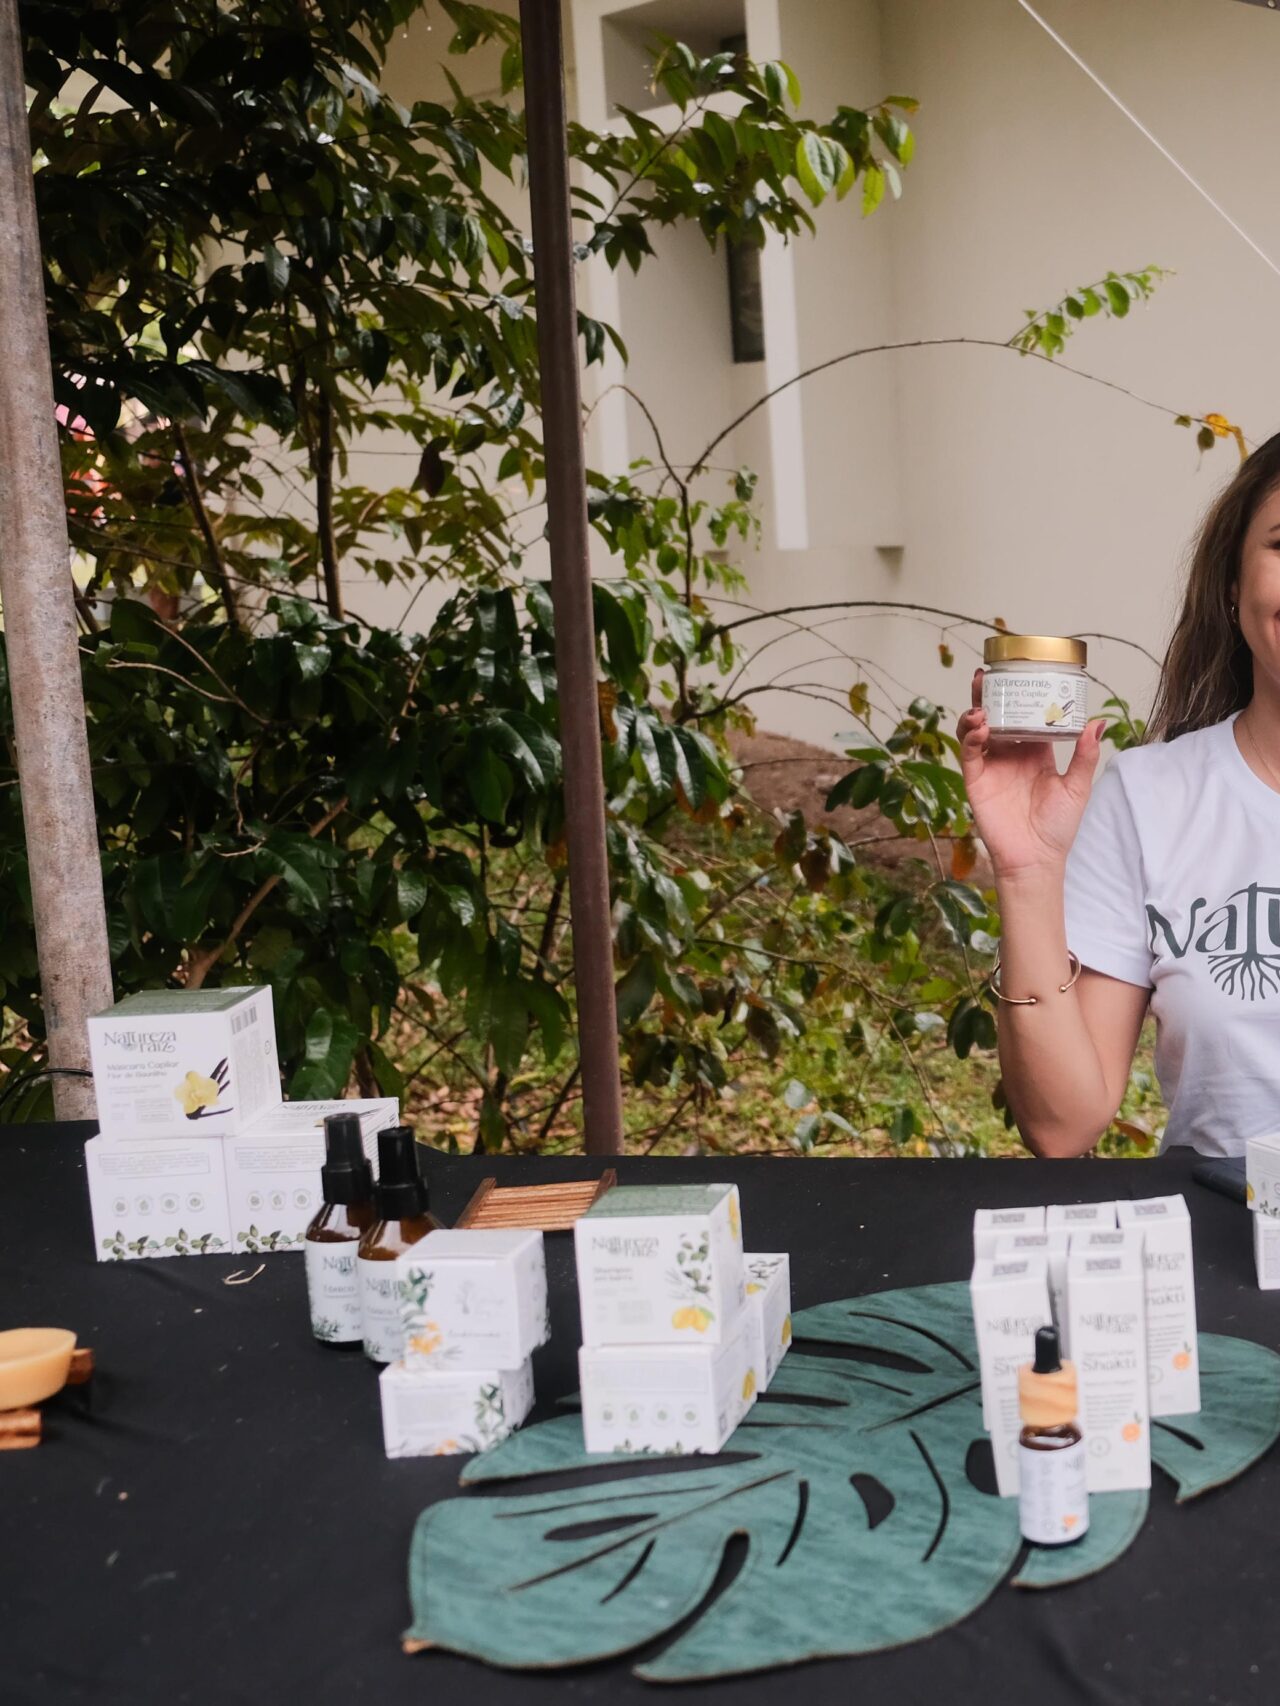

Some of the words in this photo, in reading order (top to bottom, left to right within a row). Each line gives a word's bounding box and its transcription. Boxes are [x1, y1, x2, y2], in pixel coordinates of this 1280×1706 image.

[103, 1031, 177, 1047] Natureza
[139, 1041, 177, 1053] raiz
[1081, 1357, 1138, 1373] Shakti
